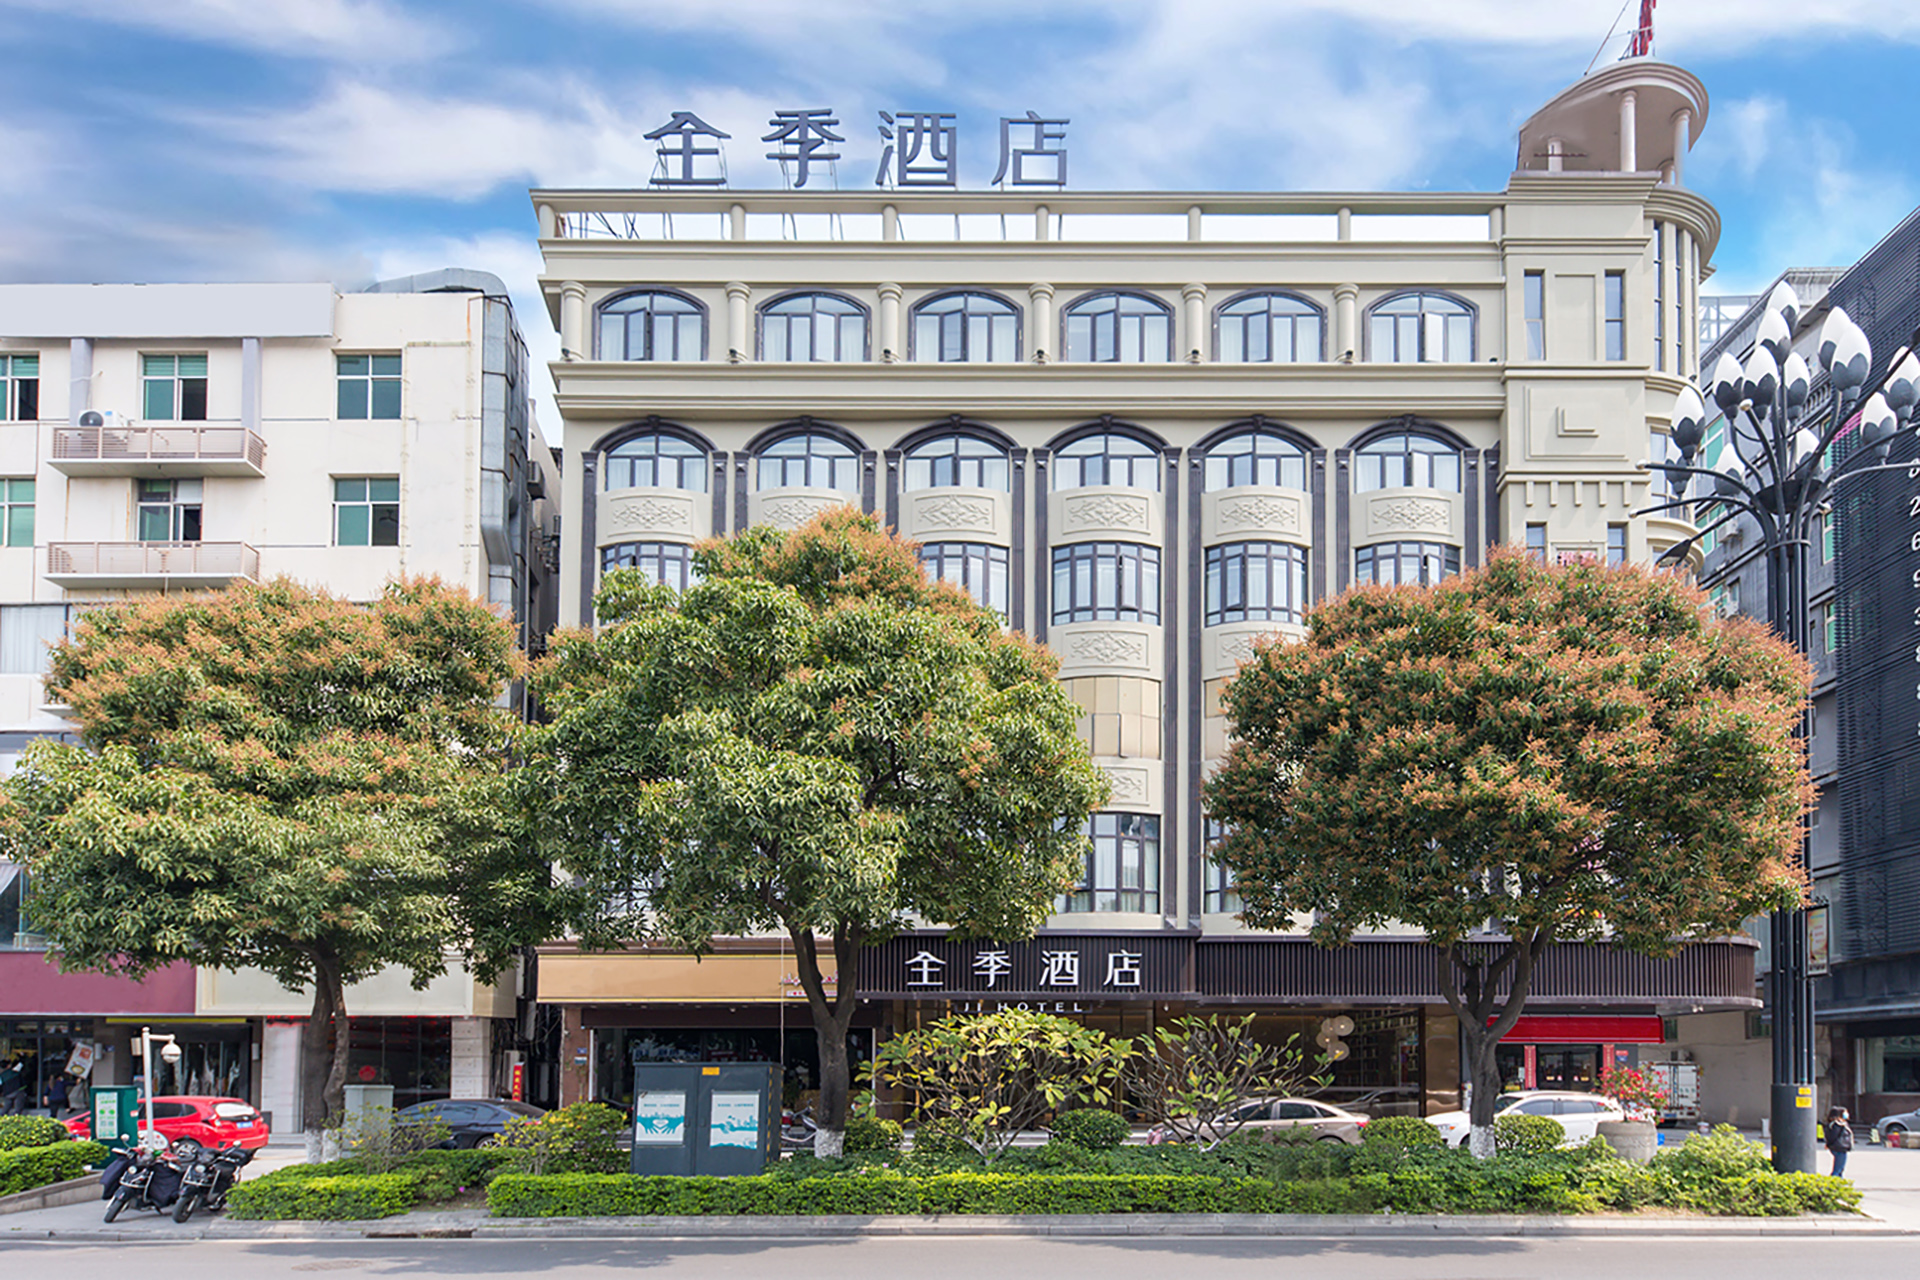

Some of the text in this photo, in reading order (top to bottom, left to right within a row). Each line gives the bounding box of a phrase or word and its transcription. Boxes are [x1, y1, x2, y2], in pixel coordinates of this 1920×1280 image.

[643, 108, 1070, 188] 全季酒店
[905, 949, 1142, 987] 全季酒店
[964, 1002, 1083, 1013] JI HOTEL
